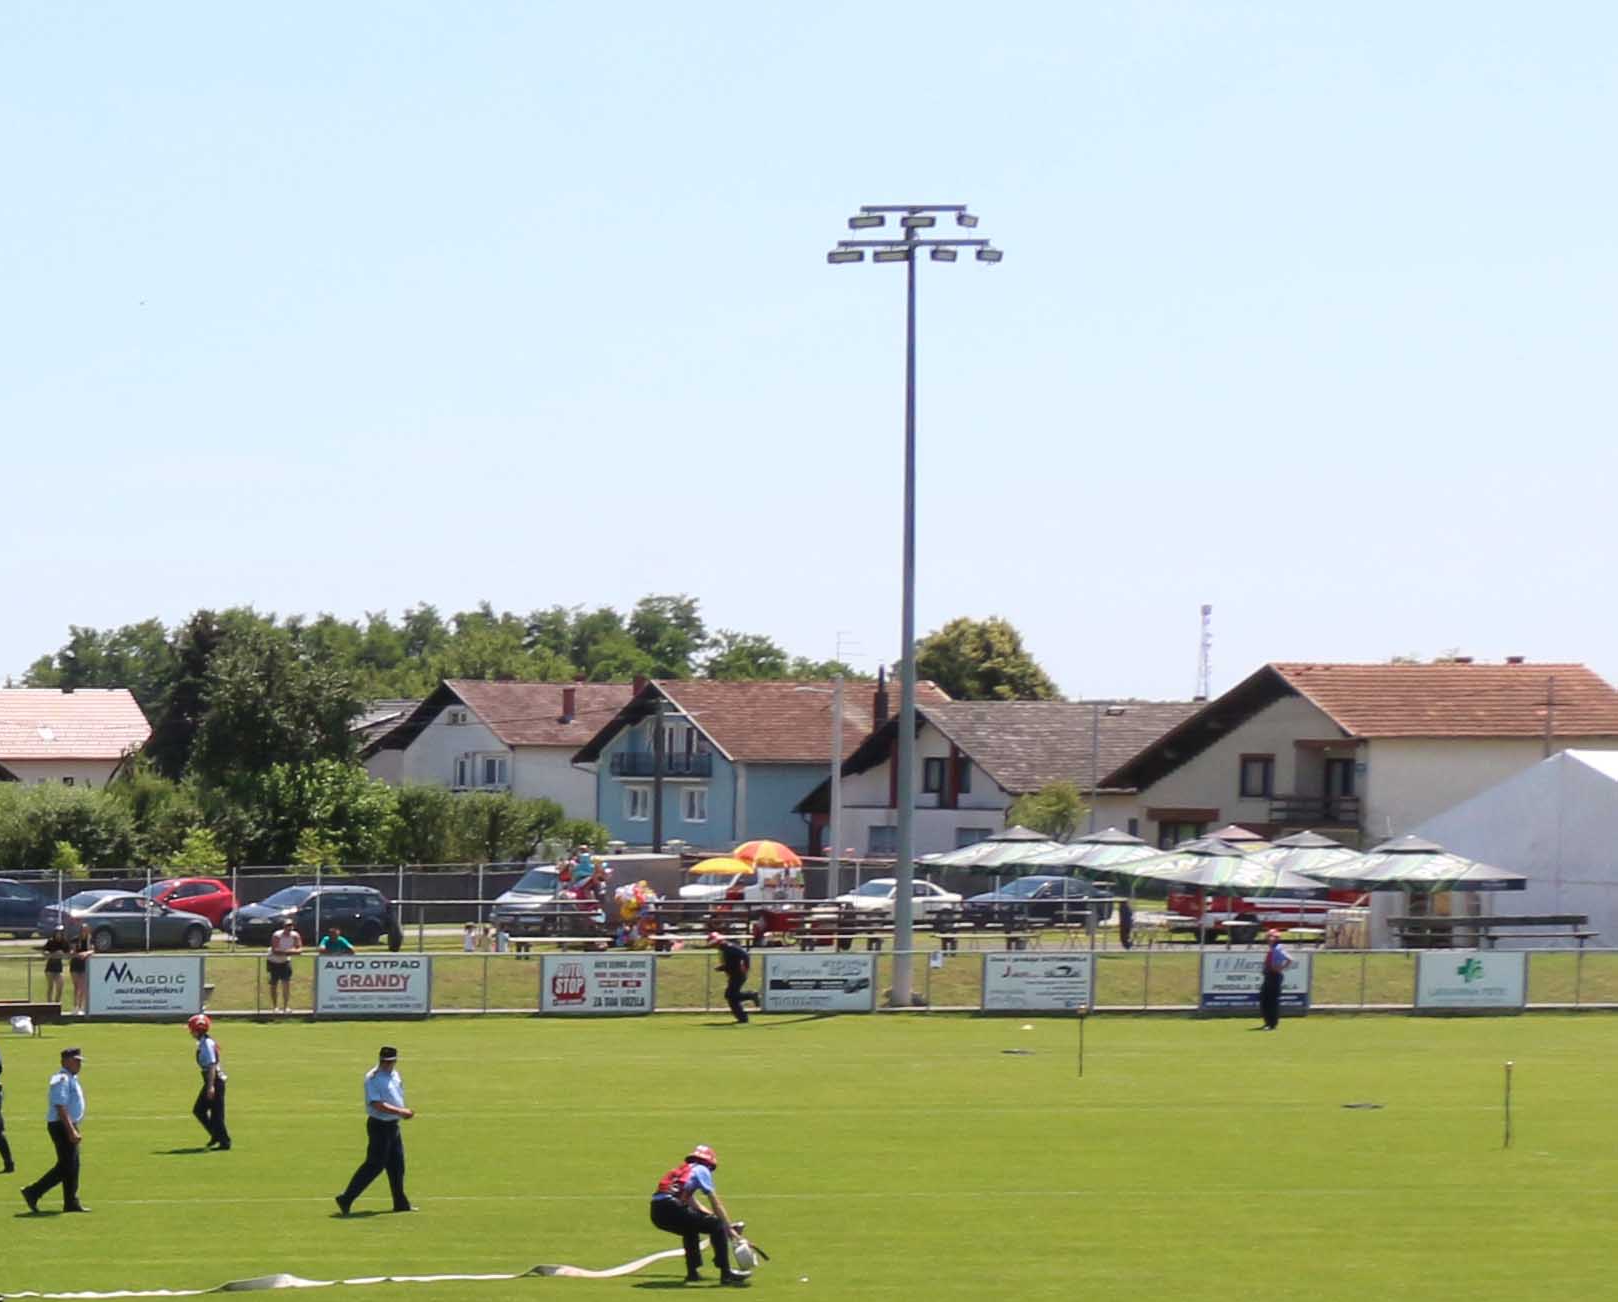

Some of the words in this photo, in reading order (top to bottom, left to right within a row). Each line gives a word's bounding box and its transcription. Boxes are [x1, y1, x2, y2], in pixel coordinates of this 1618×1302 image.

[325, 961, 364, 969] AUTO
[370, 961, 420, 969] OTPAD
[336, 974, 410, 989] GRANDY
[555, 979, 584, 994] STOP
